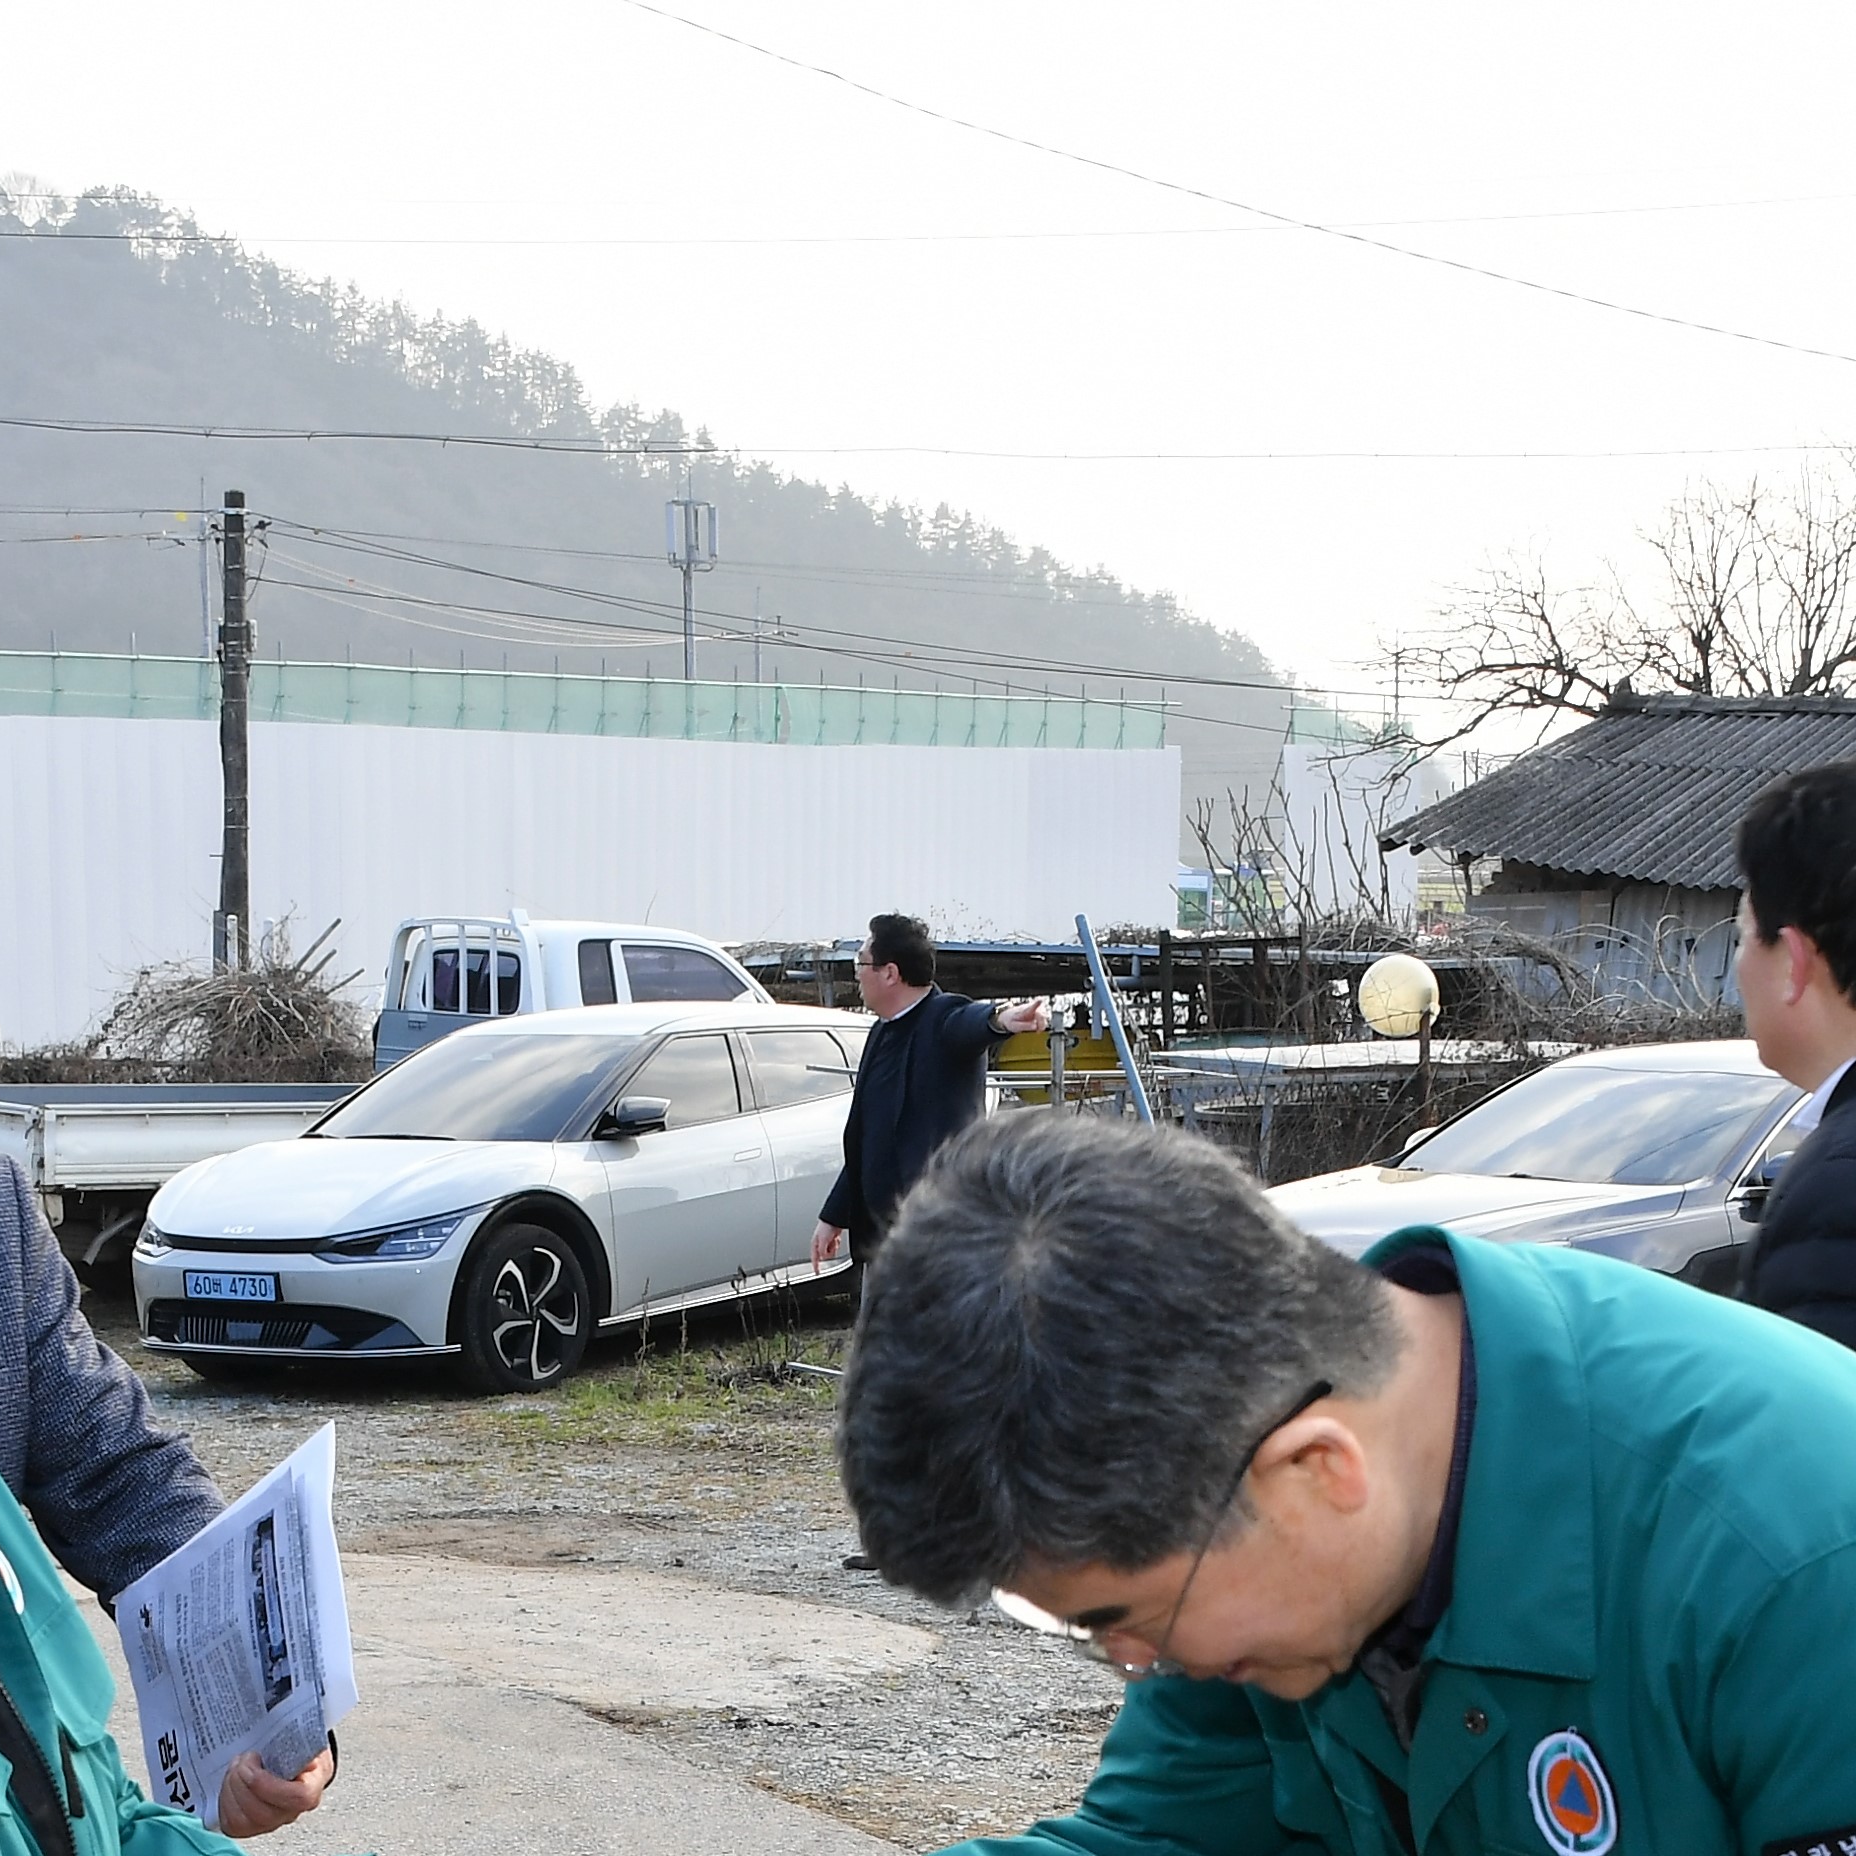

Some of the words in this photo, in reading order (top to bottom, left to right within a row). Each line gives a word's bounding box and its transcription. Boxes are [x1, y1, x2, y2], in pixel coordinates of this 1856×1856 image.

[193, 1275, 222, 1296] 60버
[229, 1277, 268, 1297] 4730
[157, 1728, 195, 1813] 신문
